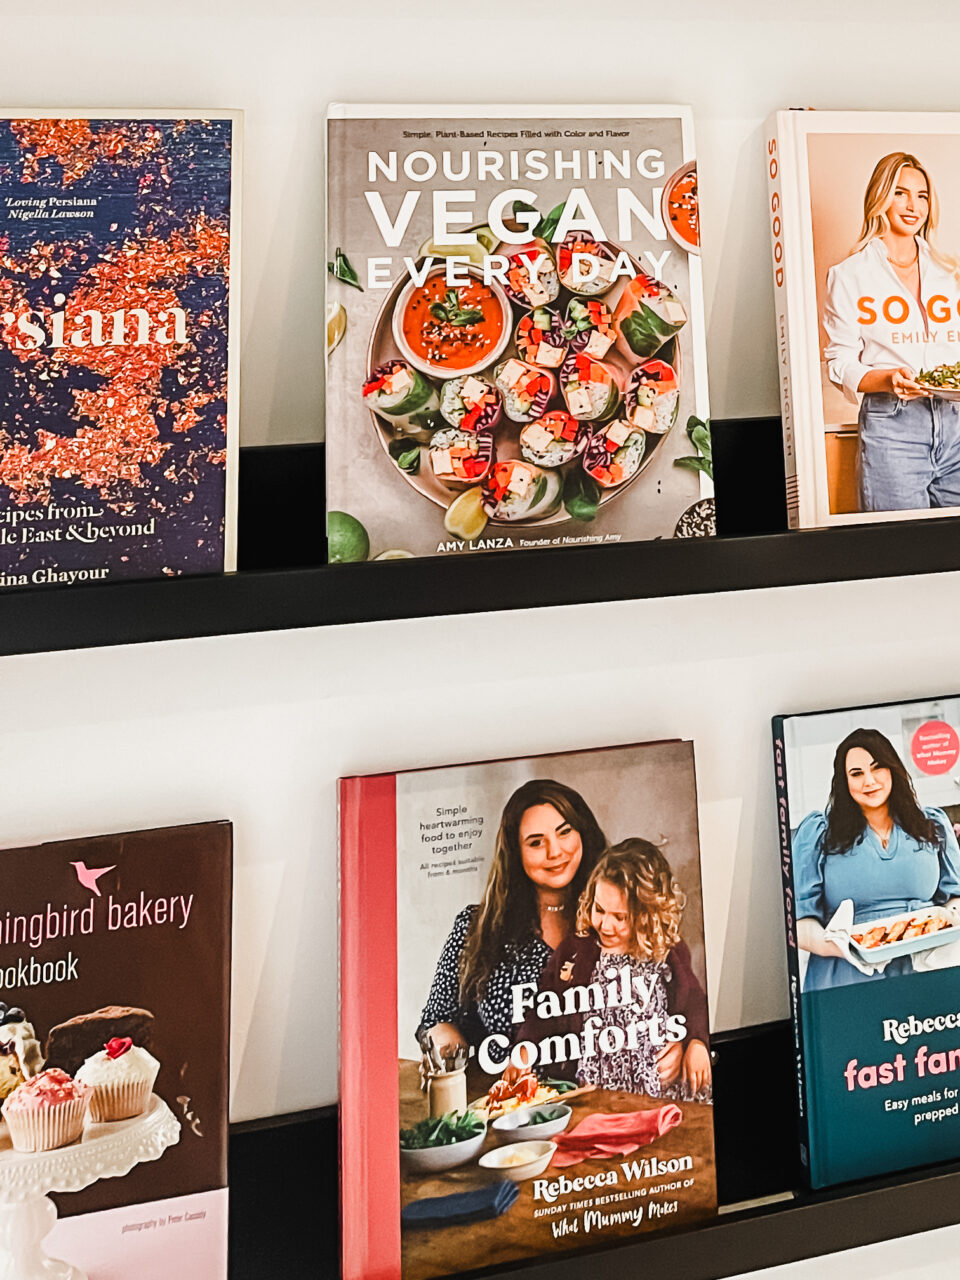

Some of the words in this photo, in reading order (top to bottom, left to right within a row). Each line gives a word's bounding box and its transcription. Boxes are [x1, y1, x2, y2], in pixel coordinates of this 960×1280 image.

[487, 131, 518, 139] Recipes
[367, 149, 665, 182] NOURISHING
[768, 138, 778, 179] SO
[8, 209, 49, 221] Nigella
[50, 209, 93, 218] Lawson
[364, 187, 668, 247] VEGAN
[772, 192, 783, 288] GOOD
[367, 253, 547, 289] EVERY
[572, 250, 671, 282] DAY
[857, 295, 909, 325] SO
[891, 330, 937, 345] EMILY
[48, 503, 104, 520] from
[22, 527, 62, 543] East
[437, 541, 466, 553] AMY
[469, 538, 514, 550] LANZA
[562, 535, 603, 544] Nourishing
[605, 534, 621, 542] Amy
[32, 568, 109, 585] Ghayour
[420, 816, 483, 830] heartwarming
[436, 805, 467, 817] Simple
[421, 832, 442, 843] food
[459, 829, 482, 839] enjoy
[432, 842, 472, 855] together
[108, 891, 193, 930] bakery
[510, 964, 660, 1024] Family
[478, 1011, 687, 1076] Comforts
[844, 1054, 906, 1091] fast
[884, 1098, 909, 1111] Easy
[911, 1090, 941, 1106] meals
[944, 1088, 959, 1099] for
[914, 1103, 959, 1125] prepped
[533, 1171, 618, 1202] Rebecca
[621, 1156, 693, 1182] Wilson
[534, 1204, 567, 1218] SUNDAY
[570, 1200, 593, 1209] TIMES
[595, 1188, 646, 1205] BESTSELLING
[649, 1182, 681, 1194] AUTHOR
[683, 1178, 694, 1188] OF
[552, 1218, 578, 1239] What
[584, 1206, 643, 1233] Mummy
[648, 1201, 678, 1219] Makes
